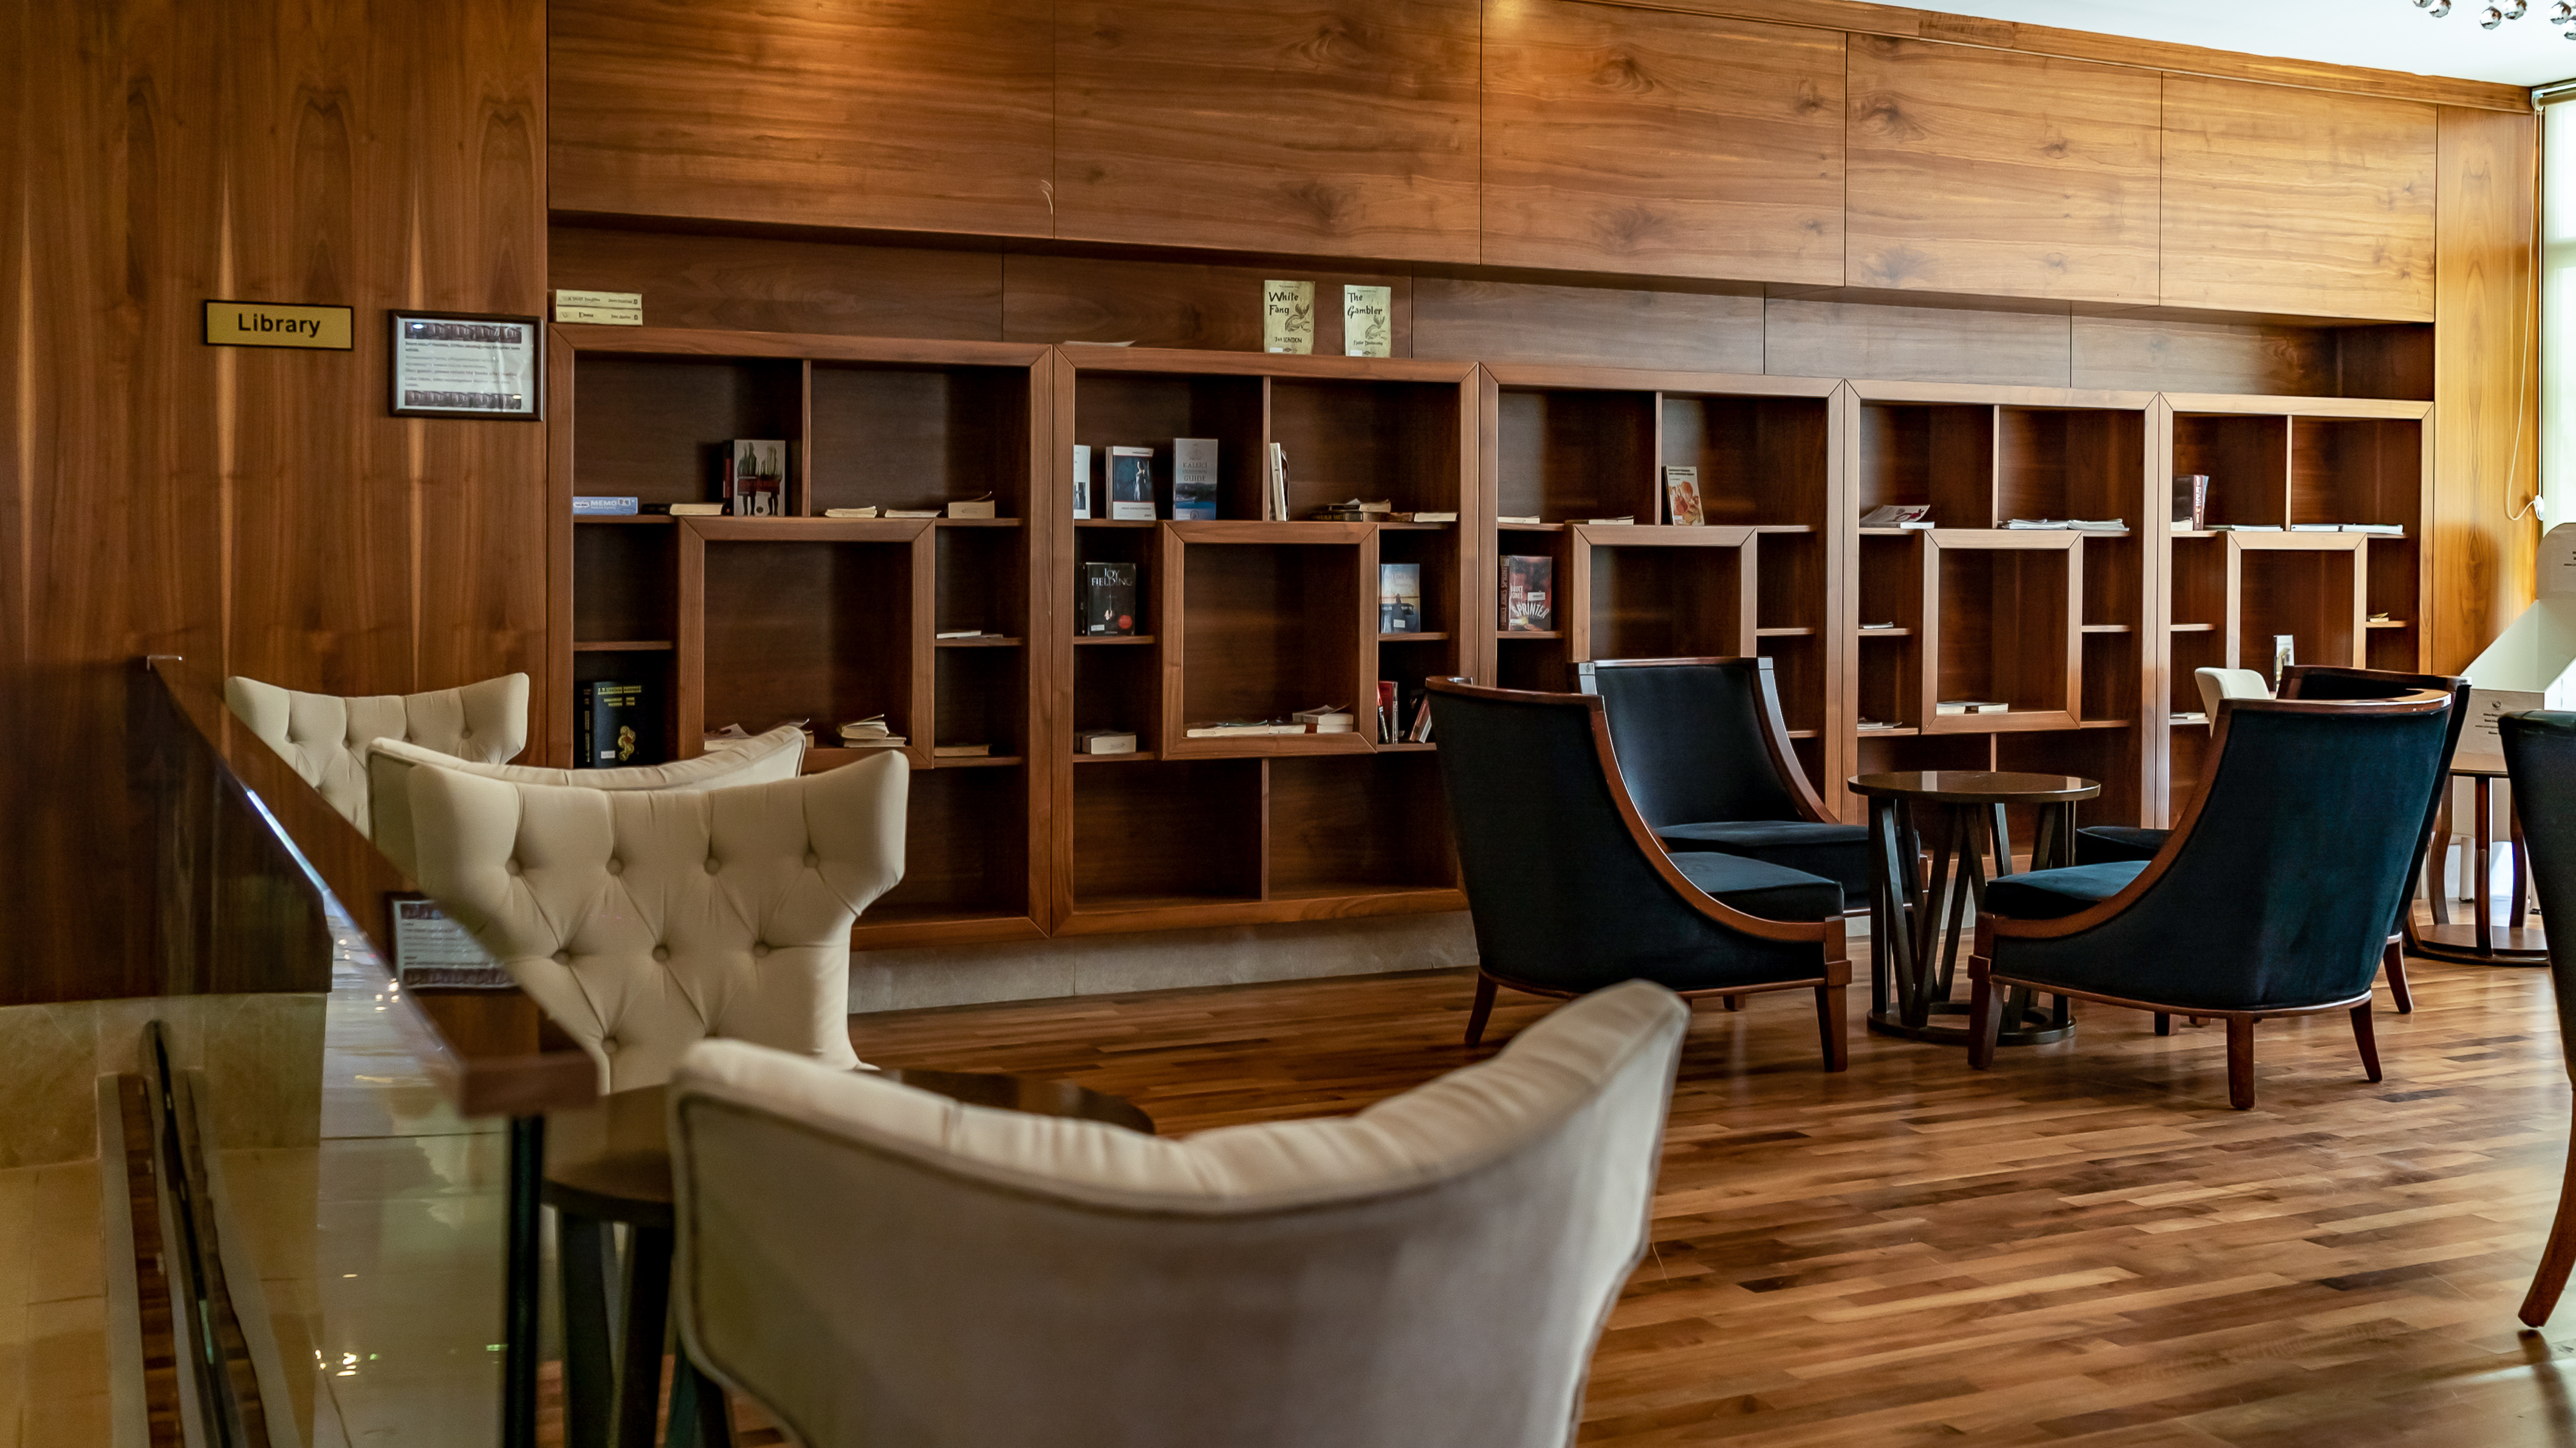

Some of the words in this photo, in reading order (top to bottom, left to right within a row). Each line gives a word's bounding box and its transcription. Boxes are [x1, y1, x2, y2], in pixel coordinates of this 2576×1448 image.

[1269, 292, 1299, 302] White
[1347, 292, 1363, 302] The
[1269, 305, 1290, 316] Fang
[1347, 305, 1383, 319] Gambler
[238, 313, 320, 338] Library
[1104, 568, 1120, 579] JOY
[1091, 577, 1133, 587] FIELDING
[1511, 601, 1550, 619] SPRINTER
